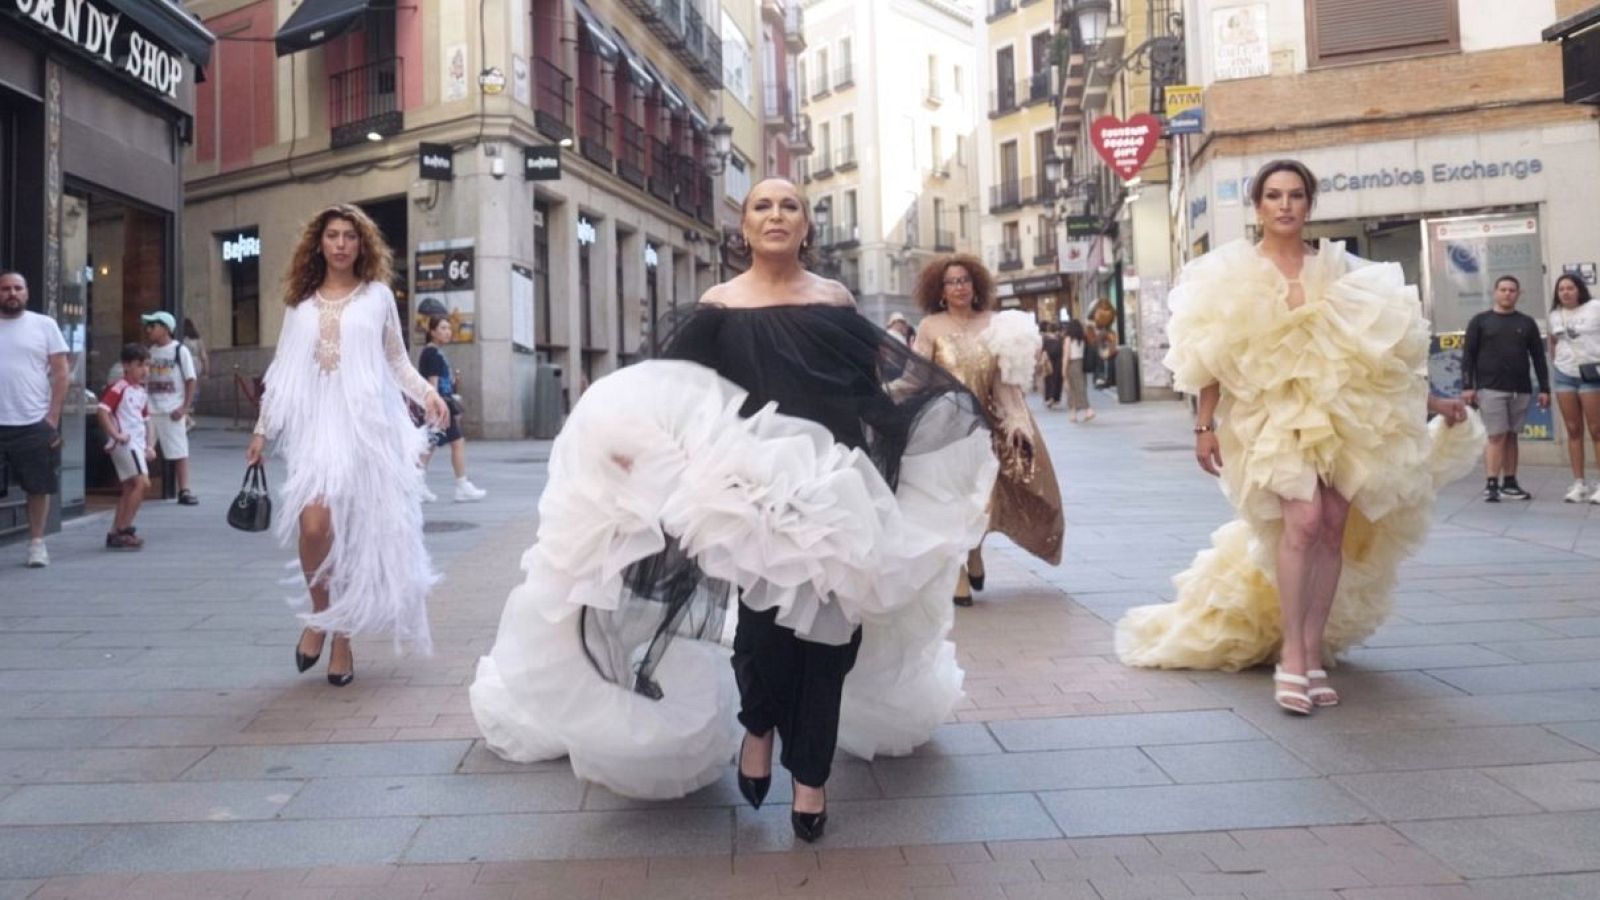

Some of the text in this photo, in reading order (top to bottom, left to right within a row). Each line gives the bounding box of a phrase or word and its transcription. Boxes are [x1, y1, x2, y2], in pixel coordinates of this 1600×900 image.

[125, 31, 183, 98] SHOP
[1168, 93, 1201, 105] ATM
[1318, 158, 1543, 193] aCambios Exchange
[449, 260, 470, 280] 6€
[1440, 335, 1461, 350] EX
[1524, 424, 1548, 438] ON
